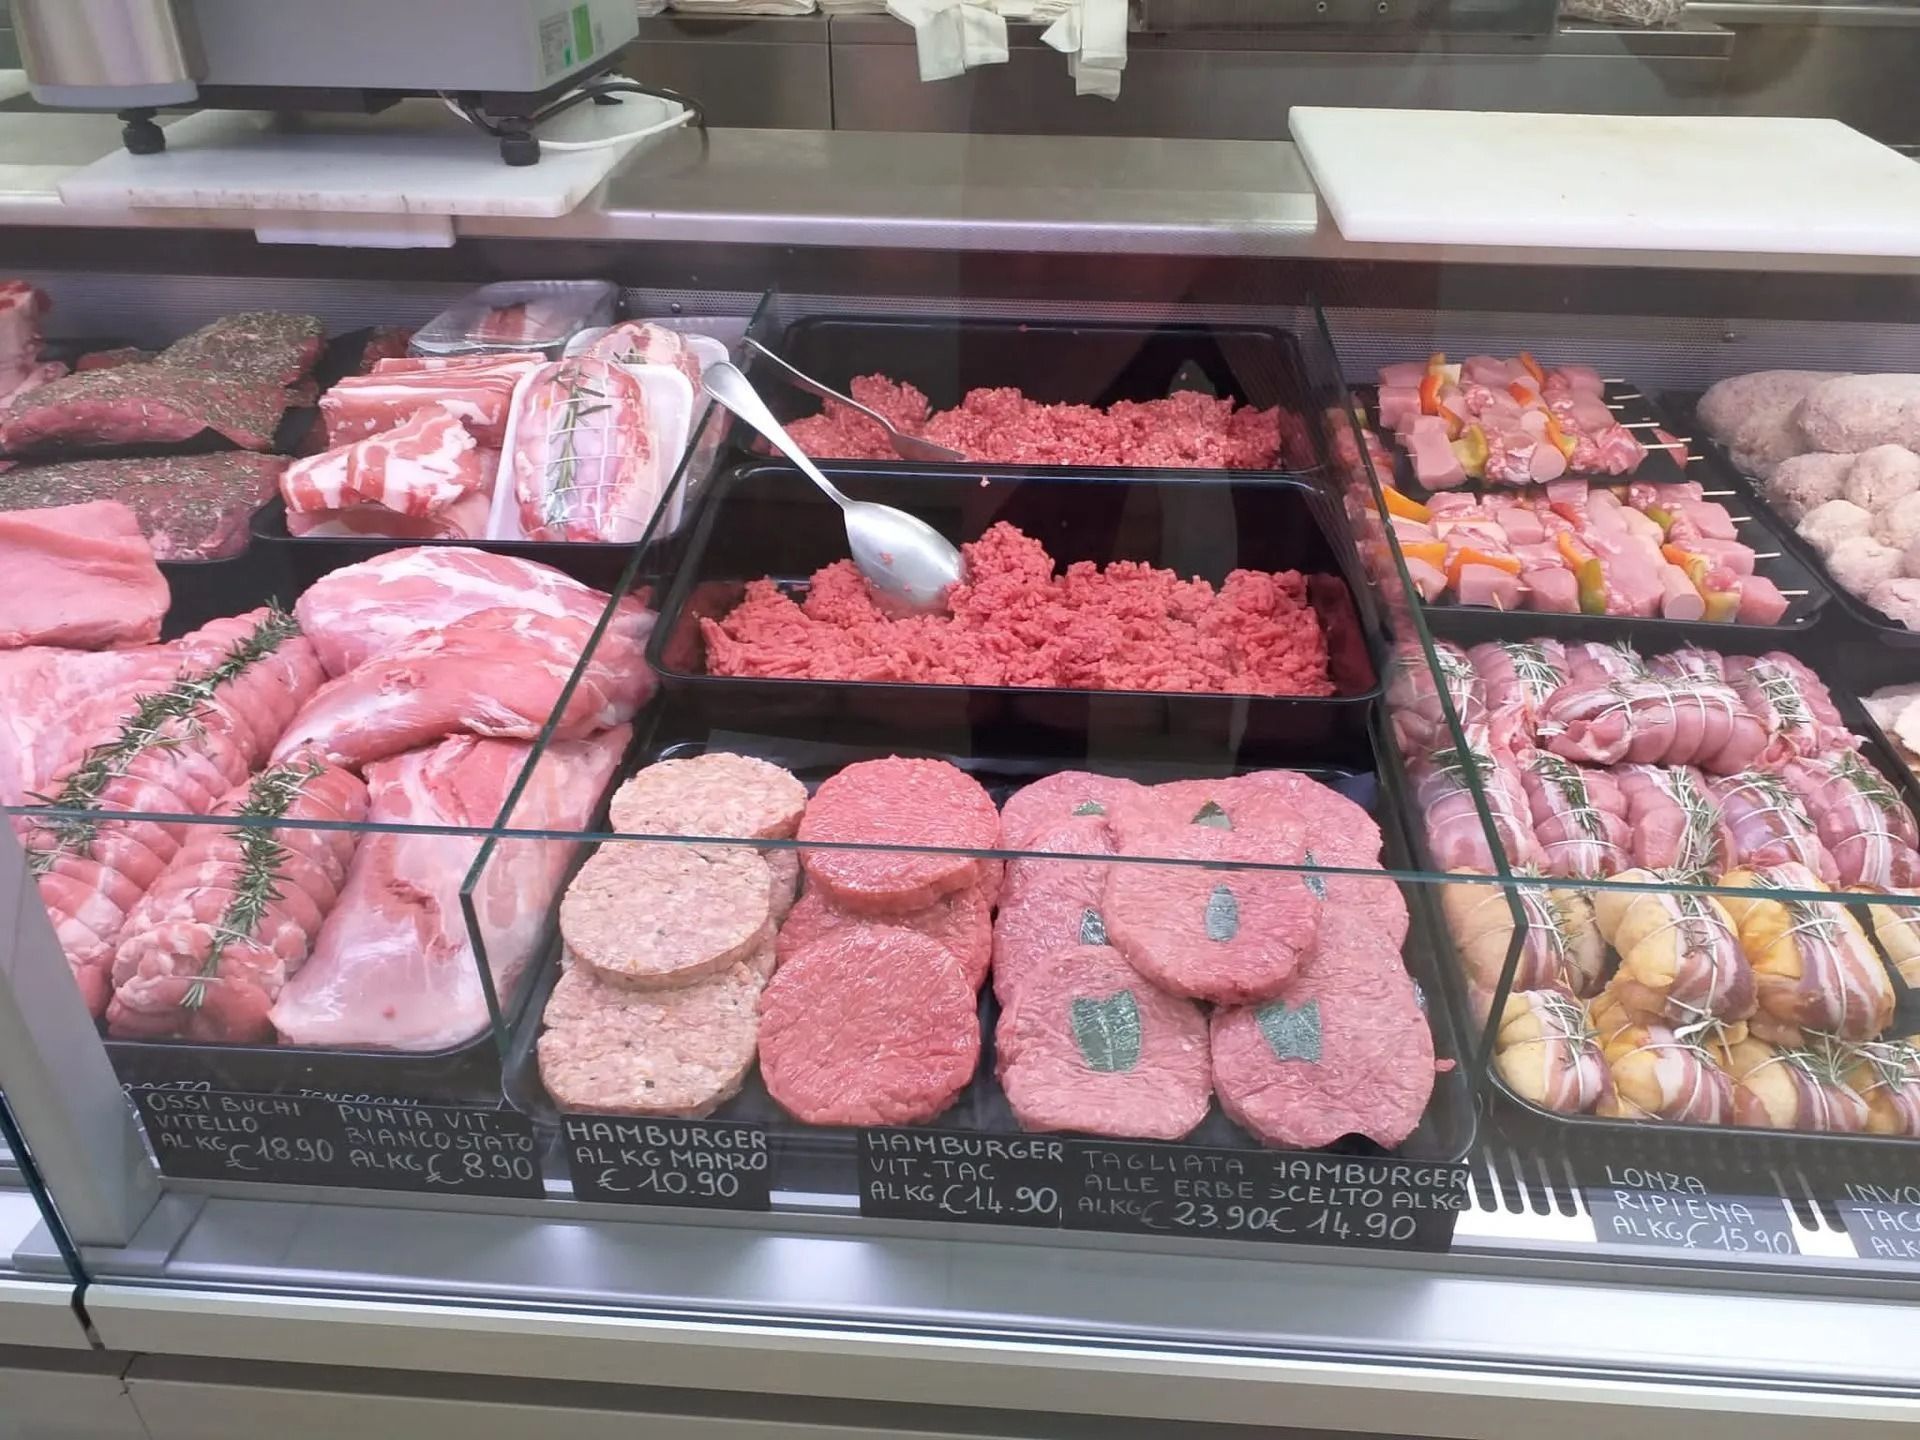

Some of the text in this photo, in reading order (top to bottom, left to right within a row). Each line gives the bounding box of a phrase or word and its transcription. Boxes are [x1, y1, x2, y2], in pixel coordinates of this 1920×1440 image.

[147, 1092, 300, 1116] OSSI BUCHI
[338, 1103, 500, 1131] PUNTA VIT.
[156, 1114, 258, 1133] VITELLO
[566, 1121, 767, 1149] HAMBURGER
[867, 1132, 1064, 1163] HAMBURGER
[1081, 1150, 1244, 1175] TAGLIATA
[1084, 1174, 1254, 1199] ALLE ERBE
[1605, 1165, 1708, 1195] LONZA
[1614, 1190, 1755, 1225] RIPIENA
[1852, 1207, 1920, 1231] TAC
